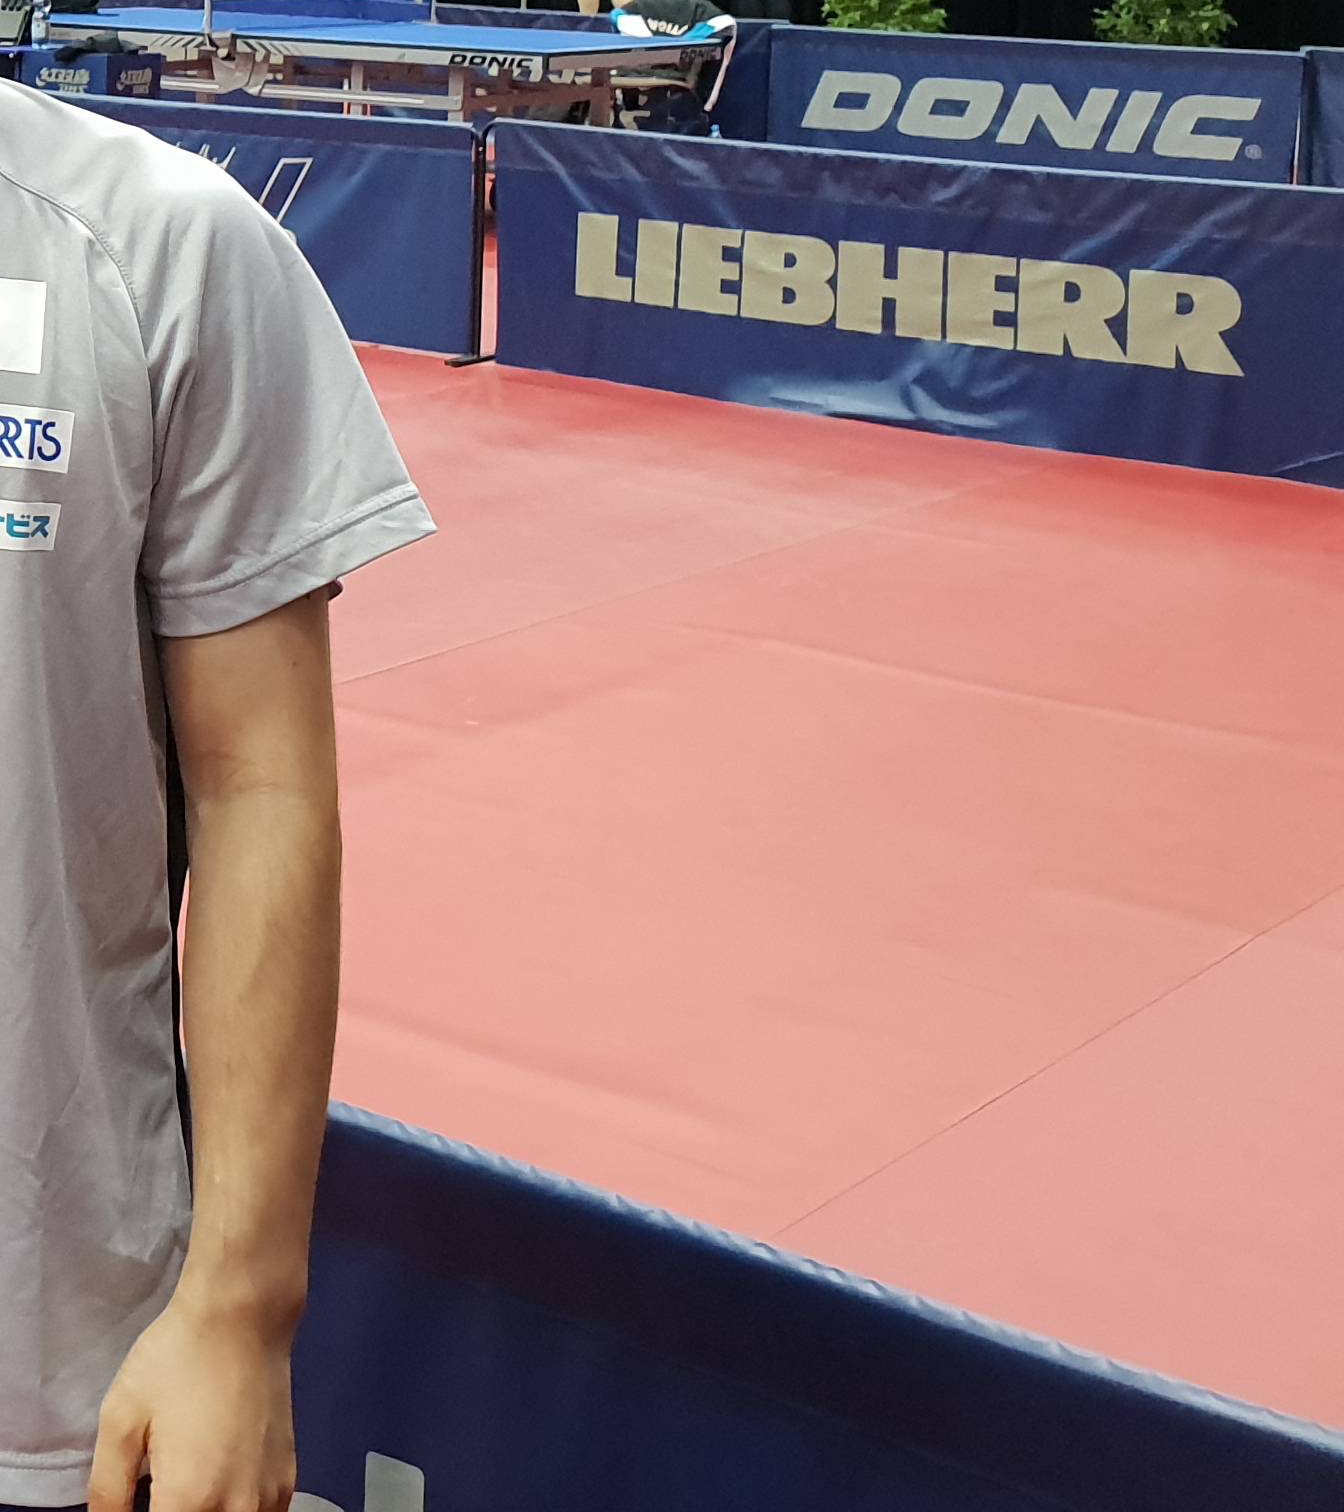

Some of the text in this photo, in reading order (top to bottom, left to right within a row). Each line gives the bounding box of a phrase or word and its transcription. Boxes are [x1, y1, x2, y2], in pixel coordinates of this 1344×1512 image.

[448, 53, 534, 69] DONIC
[801, 70, 1262, 162] DONIC
[574, 211, 1245, 378] LIEBHERR
